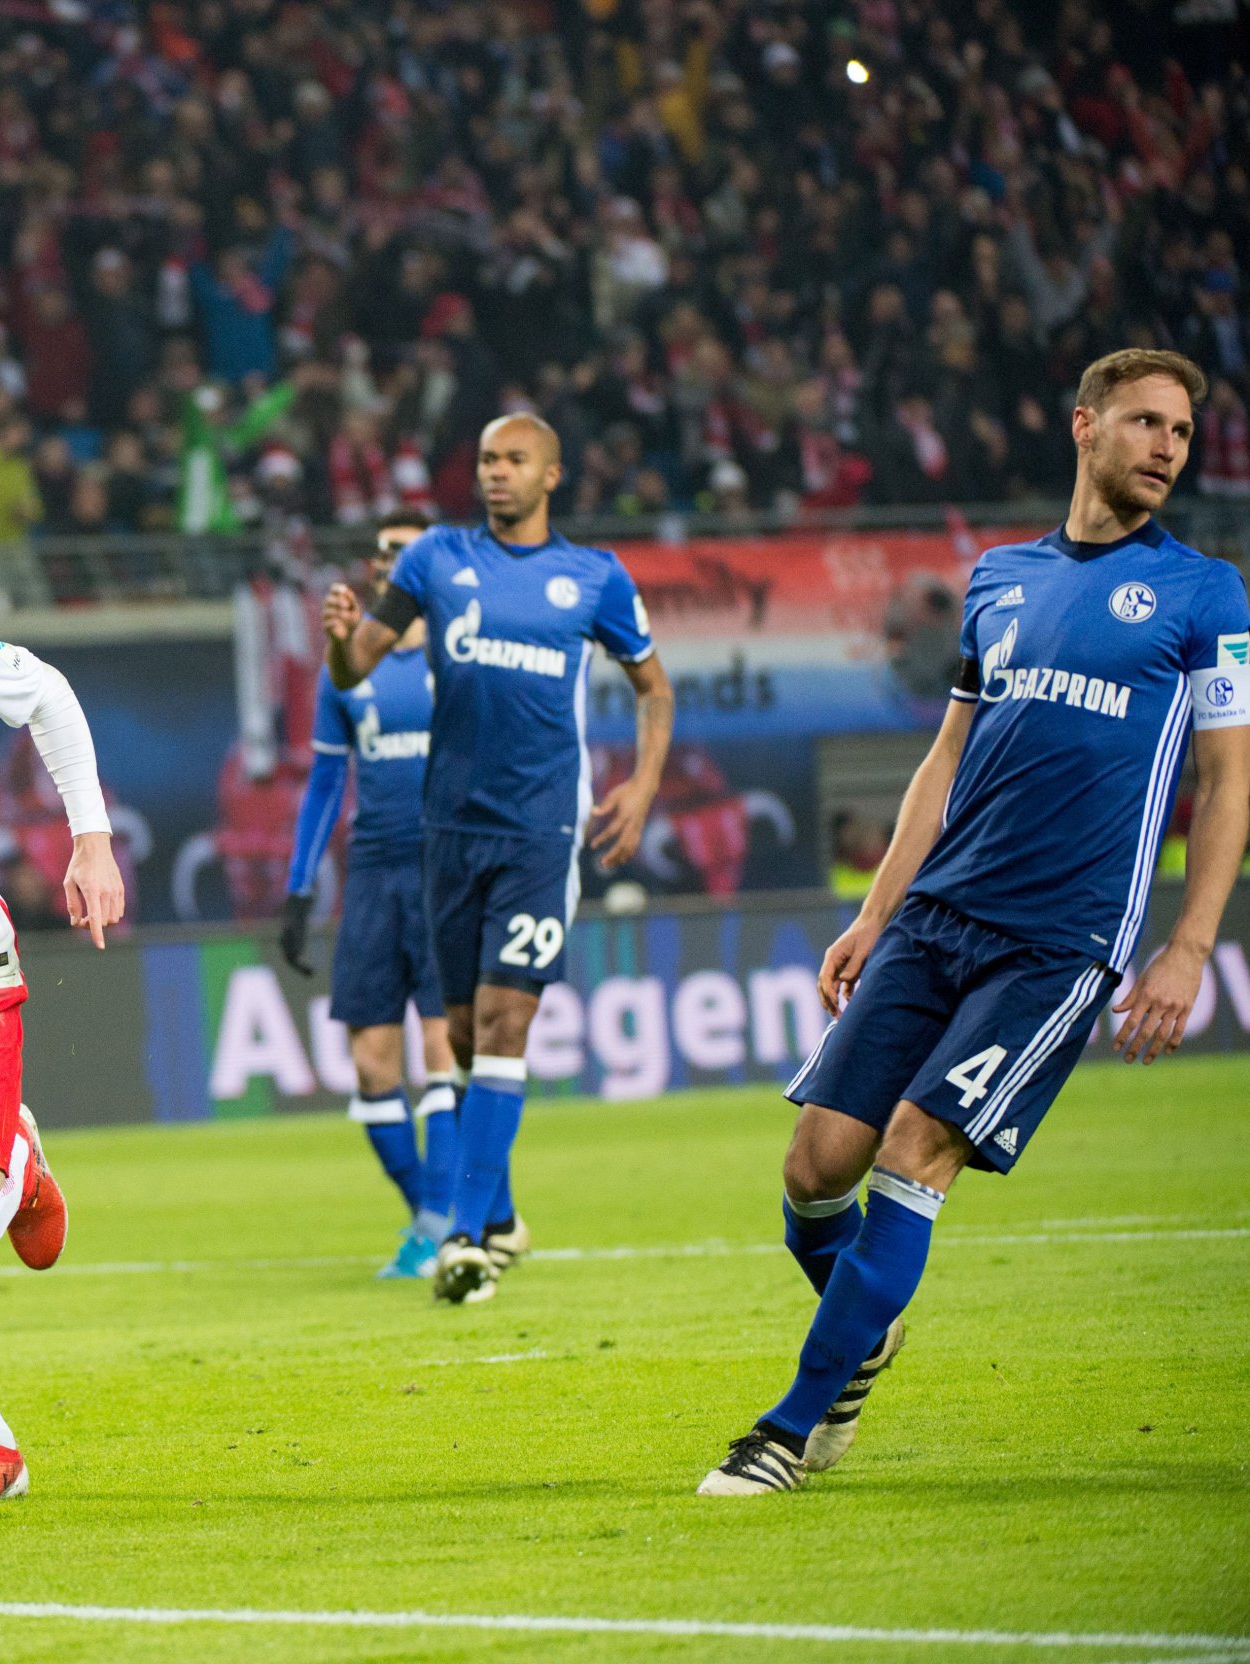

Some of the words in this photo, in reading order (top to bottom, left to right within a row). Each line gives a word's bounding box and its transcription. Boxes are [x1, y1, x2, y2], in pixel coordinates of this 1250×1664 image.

[1011, 667, 1132, 719] GAZPROM
[499, 912, 564, 969] 29
[945, 1044, 1008, 1109] 4
